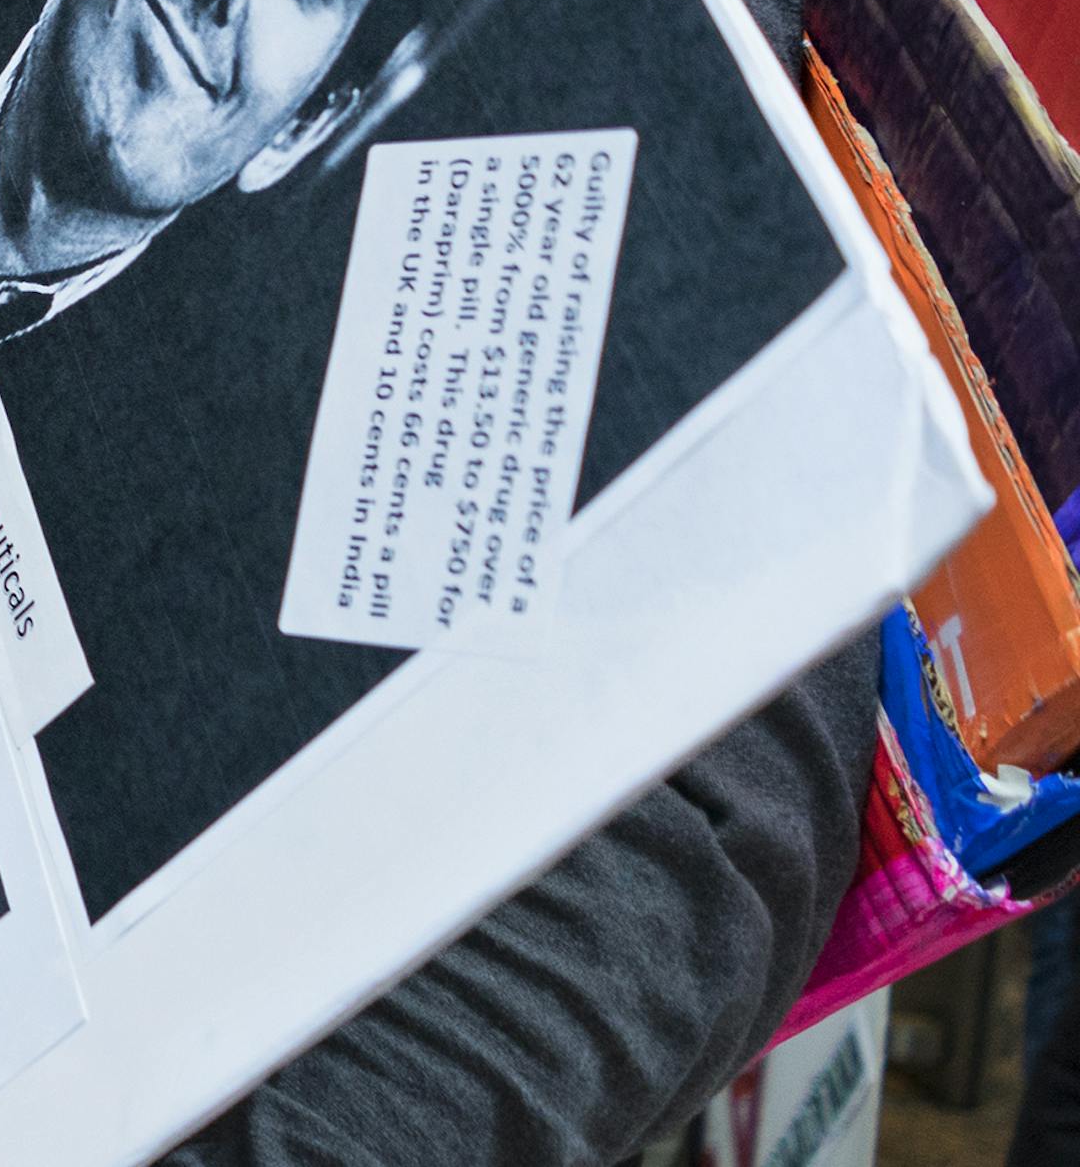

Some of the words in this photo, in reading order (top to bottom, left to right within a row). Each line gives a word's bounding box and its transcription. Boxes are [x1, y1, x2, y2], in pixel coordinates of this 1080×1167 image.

[418, 159, 439, 185] in
[486, 156, 501, 172] a
[553, 152, 576, 187] 62
[407, 195, 430, 242] the
[469, 183, 500, 268] single
[506, 154, 540, 254] 5000%
[573, 151, 611, 242] Guilty
[421, 158, 473, 318] (Daraprim)
[539, 198, 563, 263] year
[397, 253, 422, 292] UK
[570, 252, 591, 284] of
[455, 277, 480, 331] pill.
[489, 263, 521, 334] from
[528, 274, 550, 321] old
[385, 302, 408, 356] and
[547, 293, 582, 395] raising
[376, 366, 397, 401] 10
[408, 328, 434, 402] costs
[441, 347, 469, 409] This
[507, 330, 538, 445] generic
[471, 345, 506, 449] $13.50
[360, 409, 386, 489] cents
[400, 411, 423, 449] 66
[424, 418, 457, 488] drug
[541, 405, 567, 457] the
[385, 456, 412, 537] cents
[463, 457, 484, 490] to
[488, 454, 521, 525] drug
[353, 496, 376, 524] in
[524, 466, 550, 544] price
[379, 545, 395, 563] a
[447, 499, 479, 575] $750
[337, 534, 368, 609] India
[369, 572, 392, 619] pill
[478, 534, 503, 605] over
[517, 553, 537, 587] of
[437, 584, 463, 629] for
[511, 596, 527, 613] a
